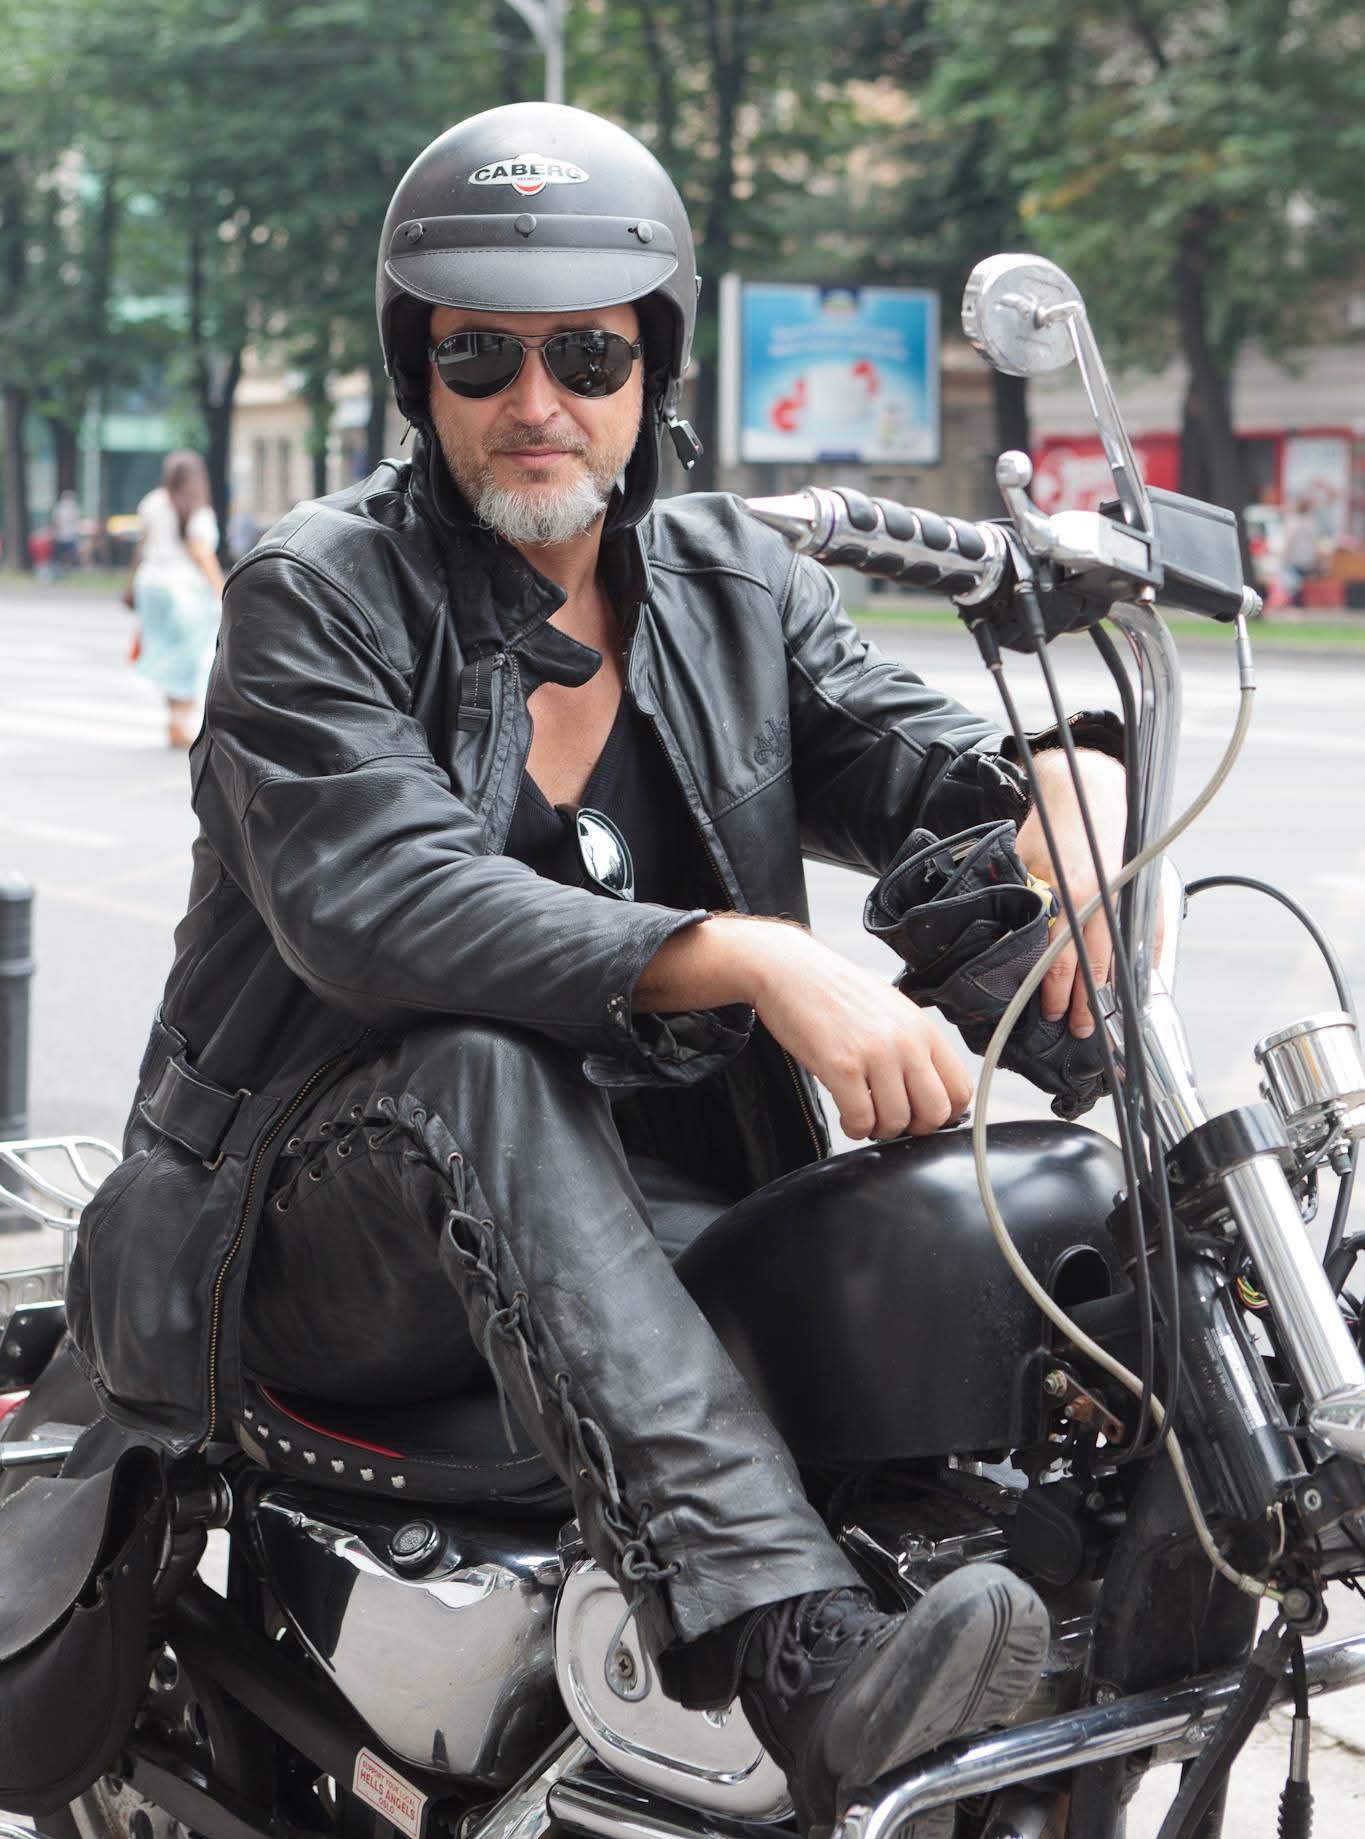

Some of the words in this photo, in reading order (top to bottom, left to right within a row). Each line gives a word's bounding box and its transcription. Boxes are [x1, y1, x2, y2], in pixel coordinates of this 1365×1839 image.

[474, 163, 583, 182] CABERG
[362, 1761, 384, 1780] SUPPORT
[386, 1779, 399, 1793] YOUR
[360, 1769, 384, 1795] HELLS
[385, 1790, 415, 1820] ANGELS
[379, 1797, 395, 1814] OSLO
